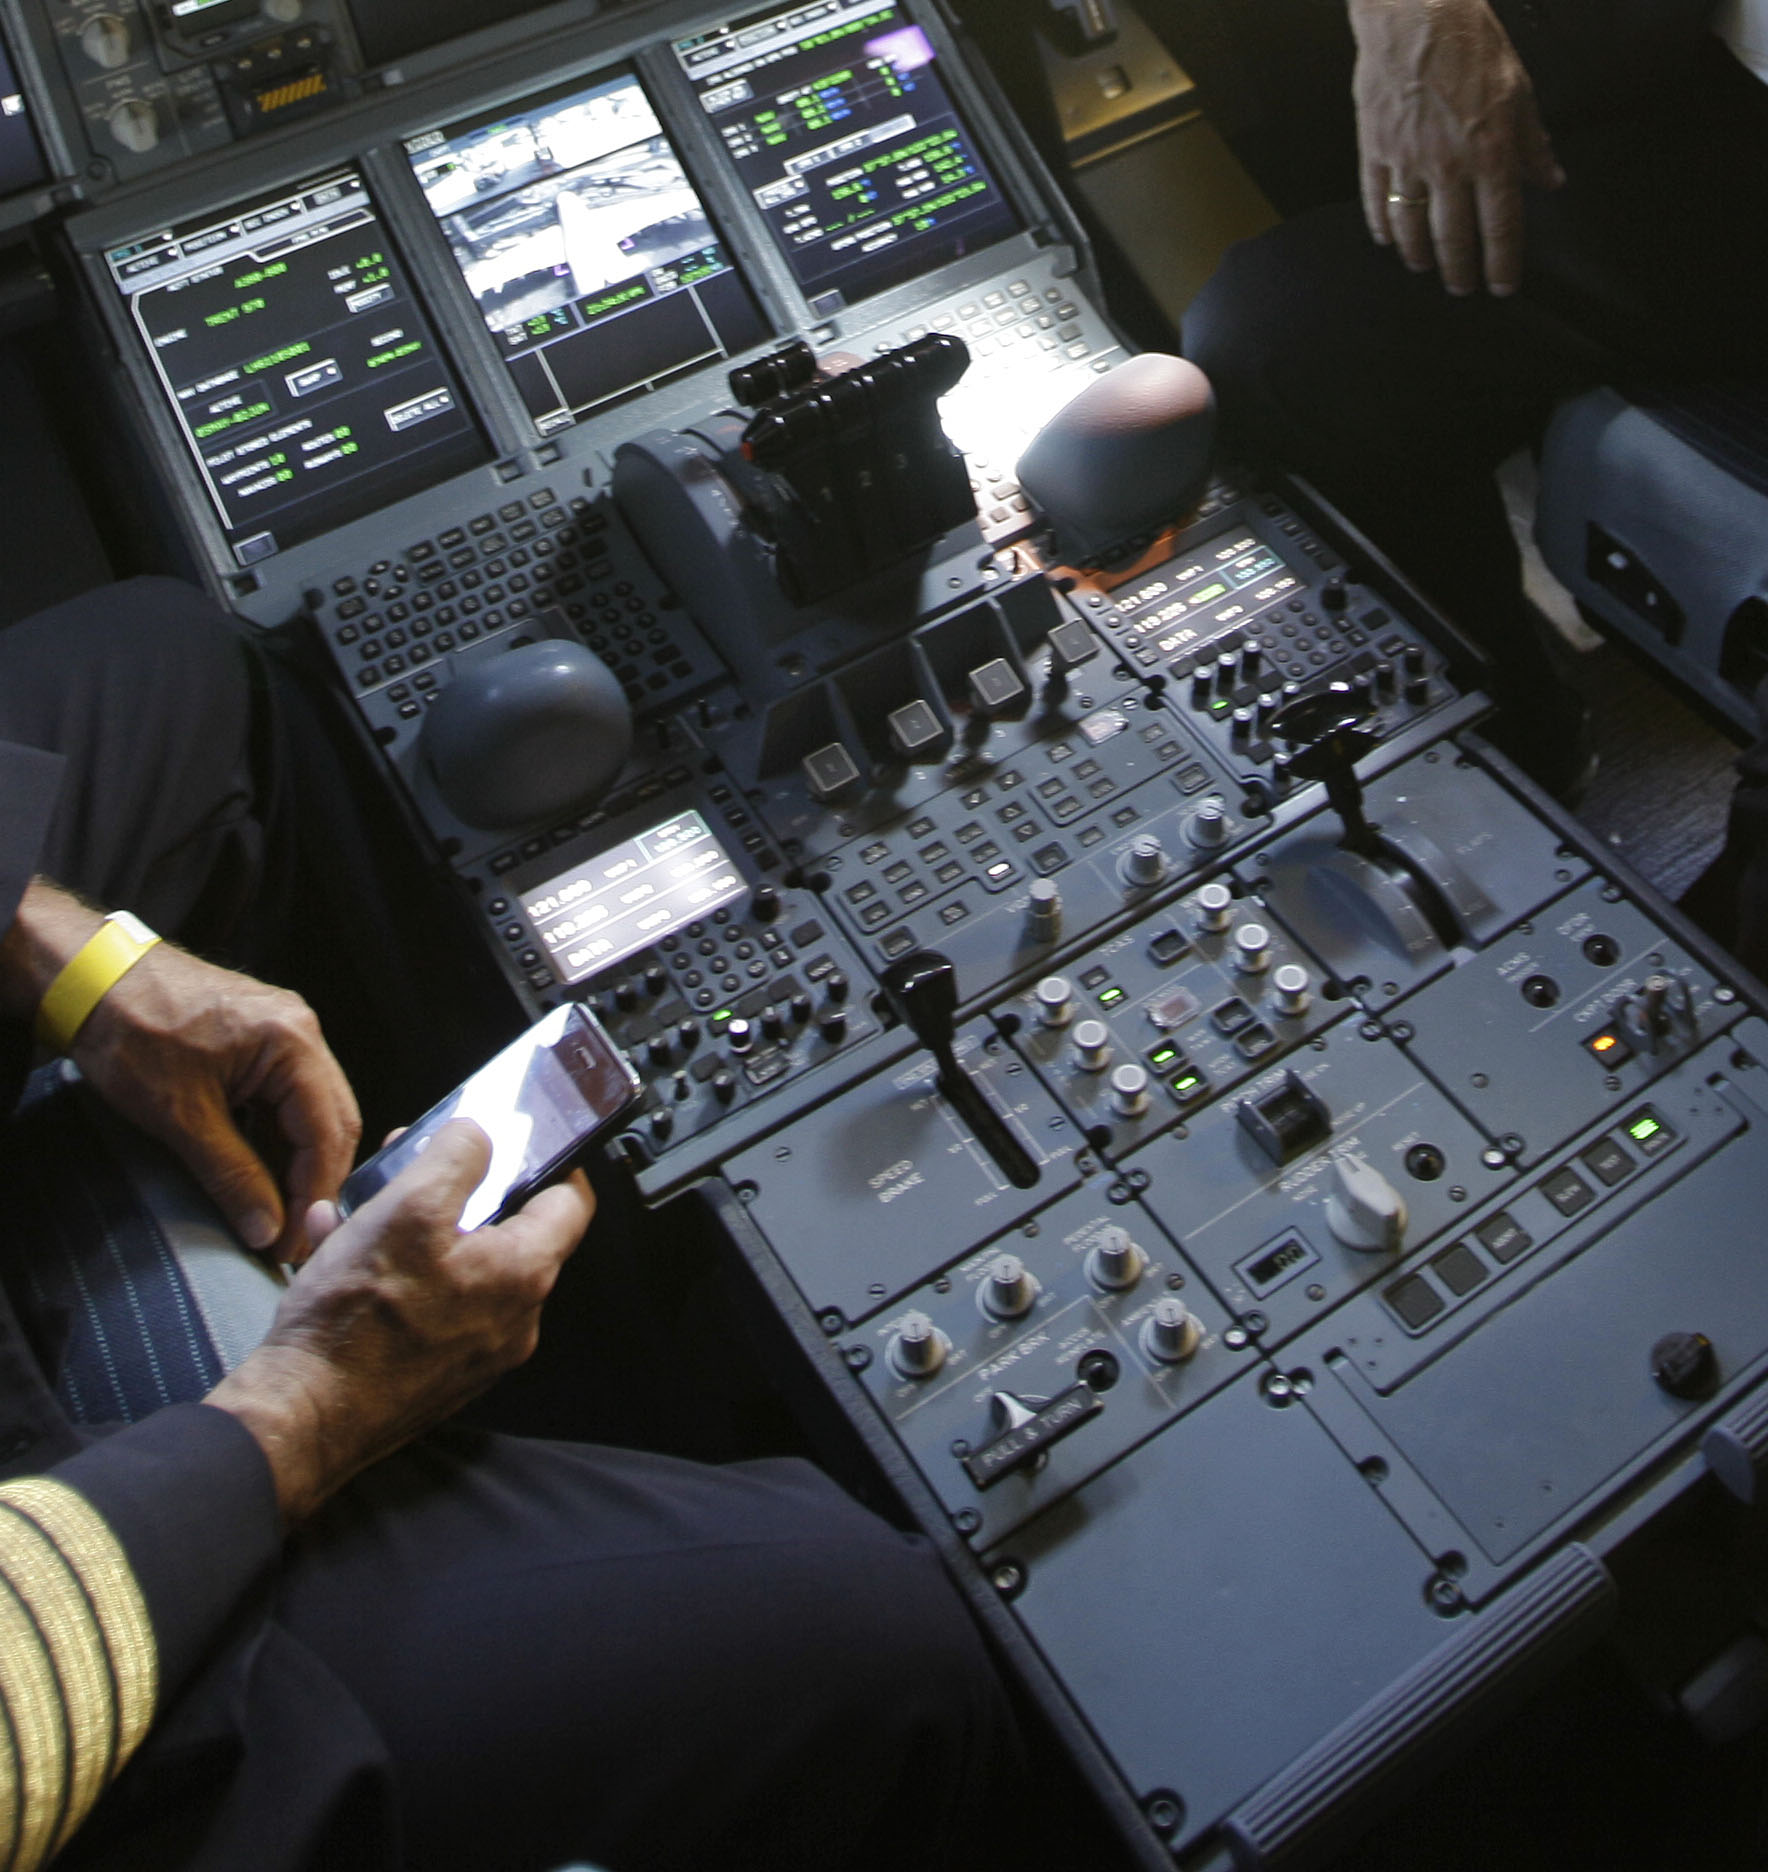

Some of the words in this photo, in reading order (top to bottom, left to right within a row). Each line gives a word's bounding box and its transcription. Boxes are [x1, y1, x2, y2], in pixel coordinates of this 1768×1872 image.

[1159, 629, 1197, 651] DATA
[568, 938, 614, 967] DATA
[869, 1160, 913, 1188] SPEED
[878, 1172, 925, 1203] BRAKE
[978, 1350, 1020, 1380] PARK
[1018, 1333, 1051, 1356] BRK
[983, 1440, 1024, 1467] PULL
[1024, 1428, 1038, 1441] &
[1039, 1399, 1082, 1428] TURN
